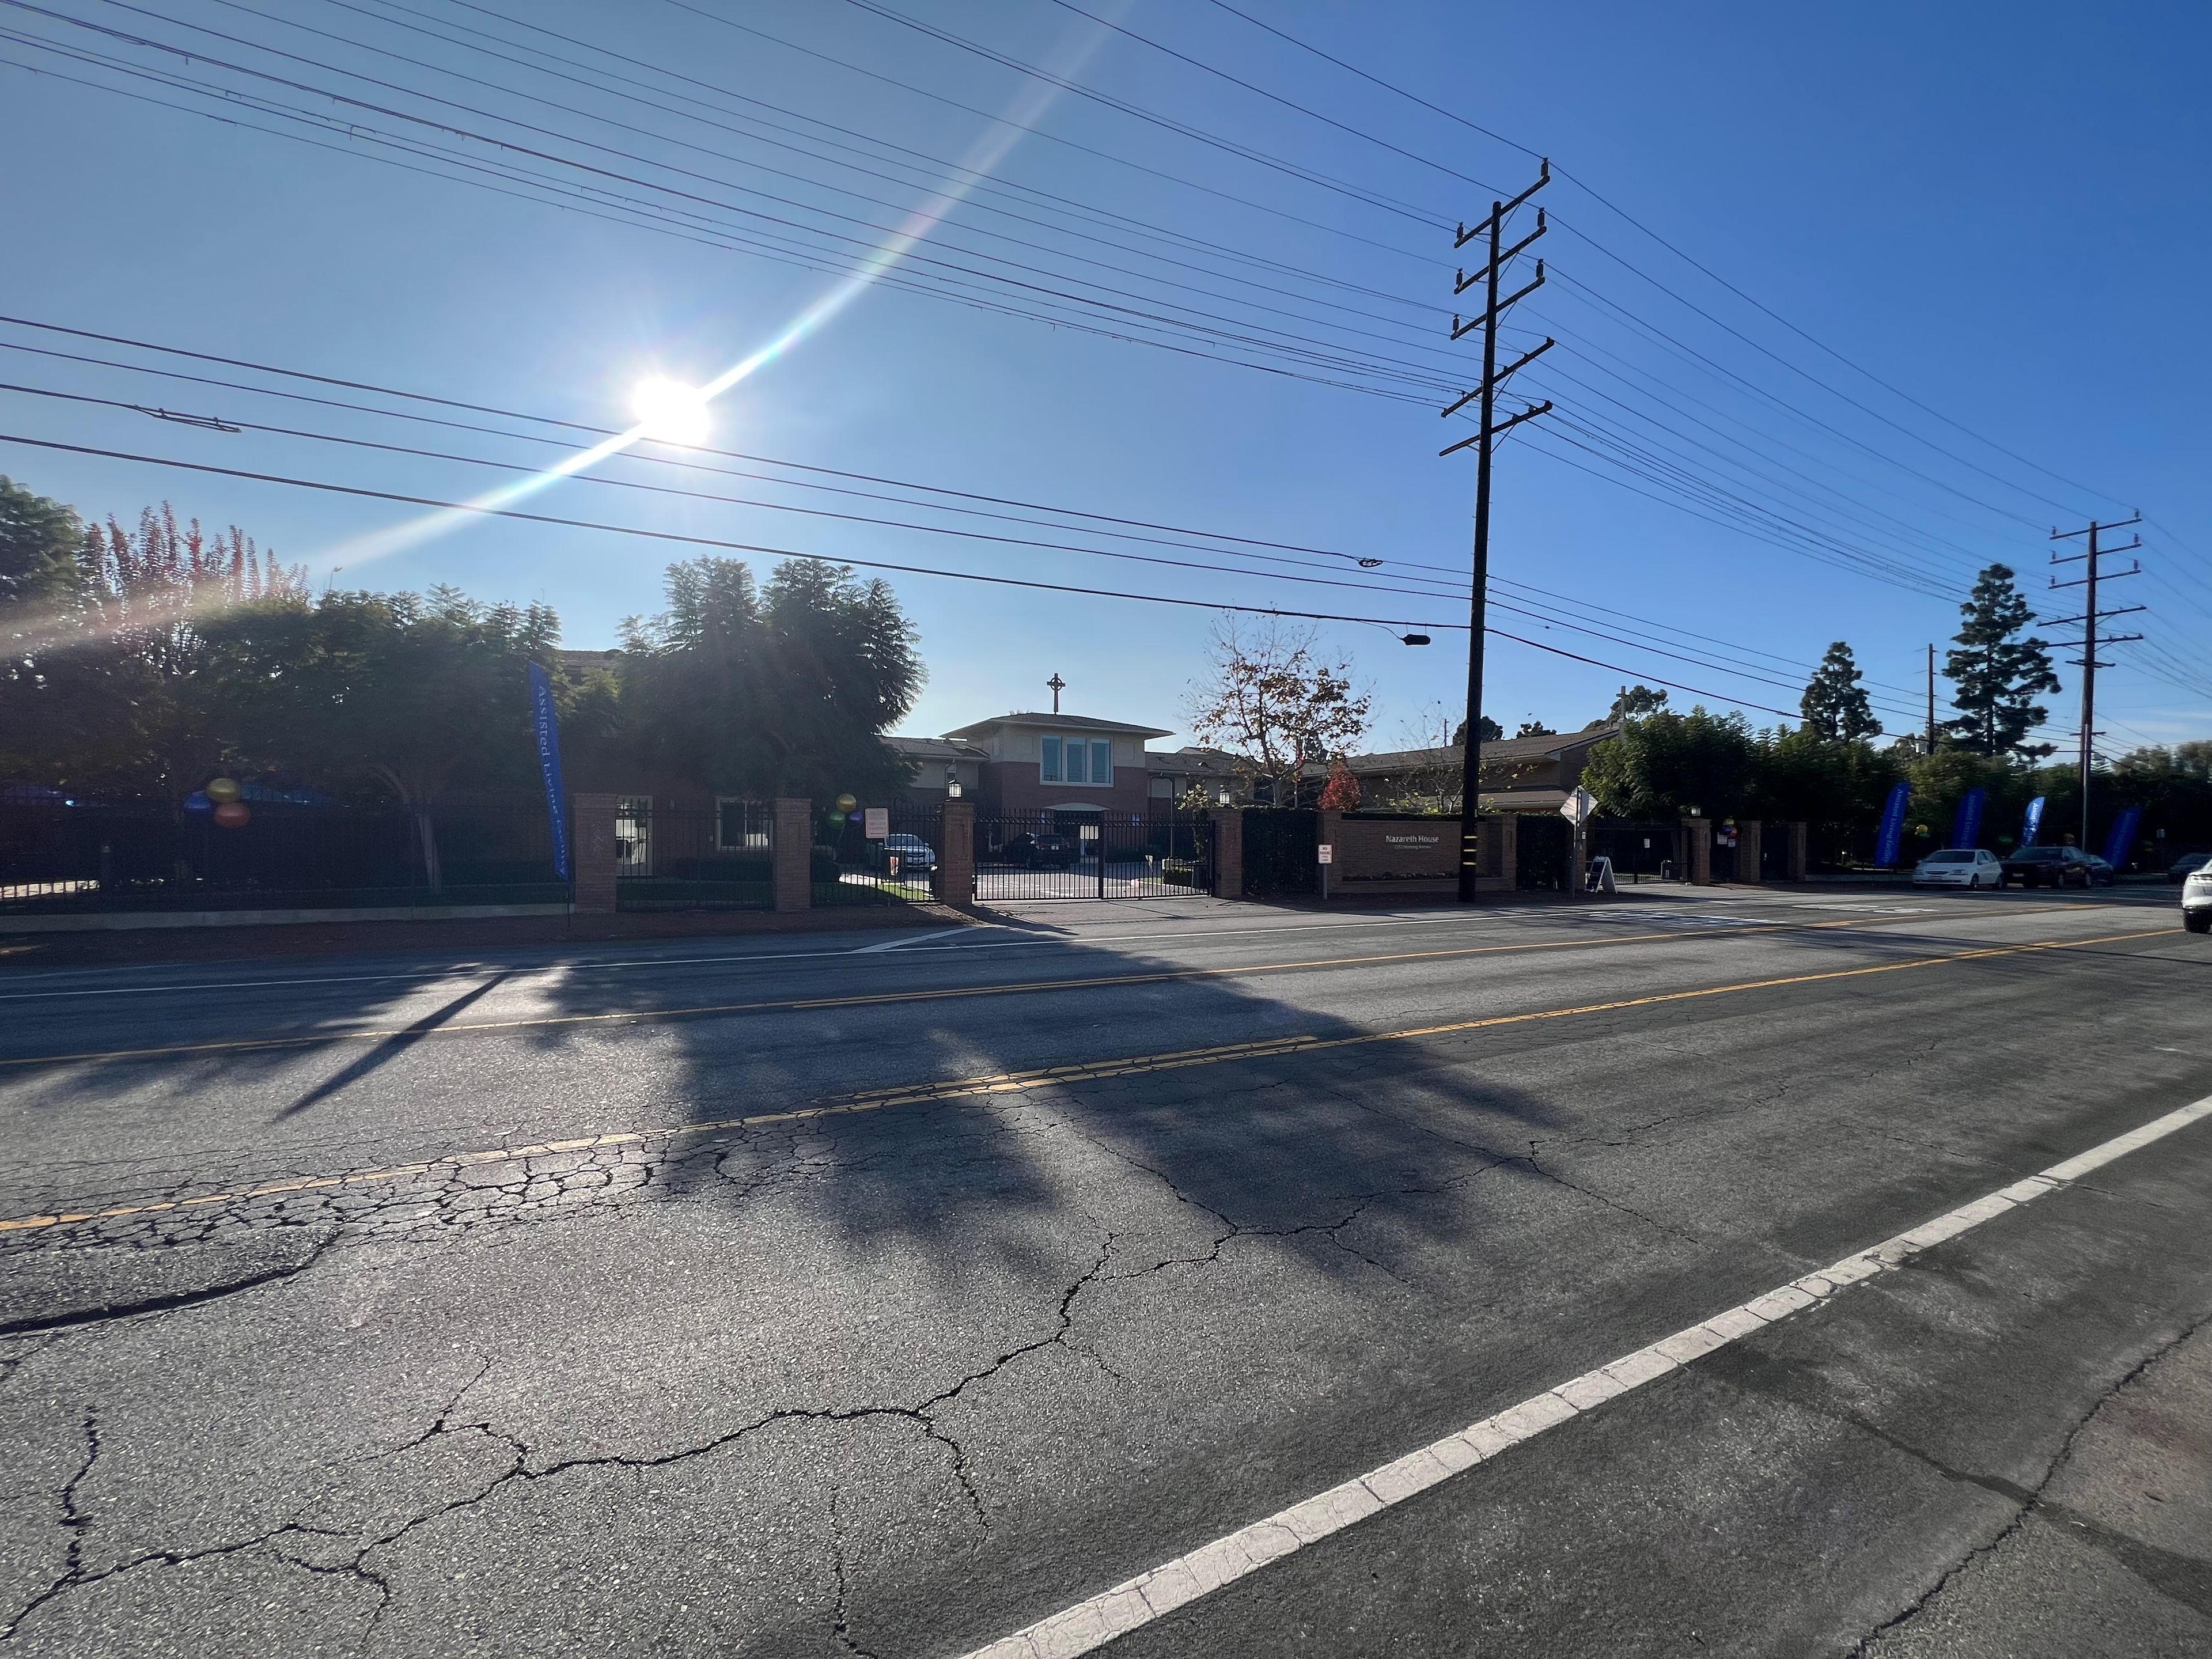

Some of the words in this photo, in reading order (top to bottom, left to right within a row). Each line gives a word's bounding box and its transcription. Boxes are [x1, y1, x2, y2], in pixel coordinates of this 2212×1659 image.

[539, 684, 550, 756] Assisted
[1386, 835, 1417, 843] Nazareth
[1418, 835, 1439, 843] House
